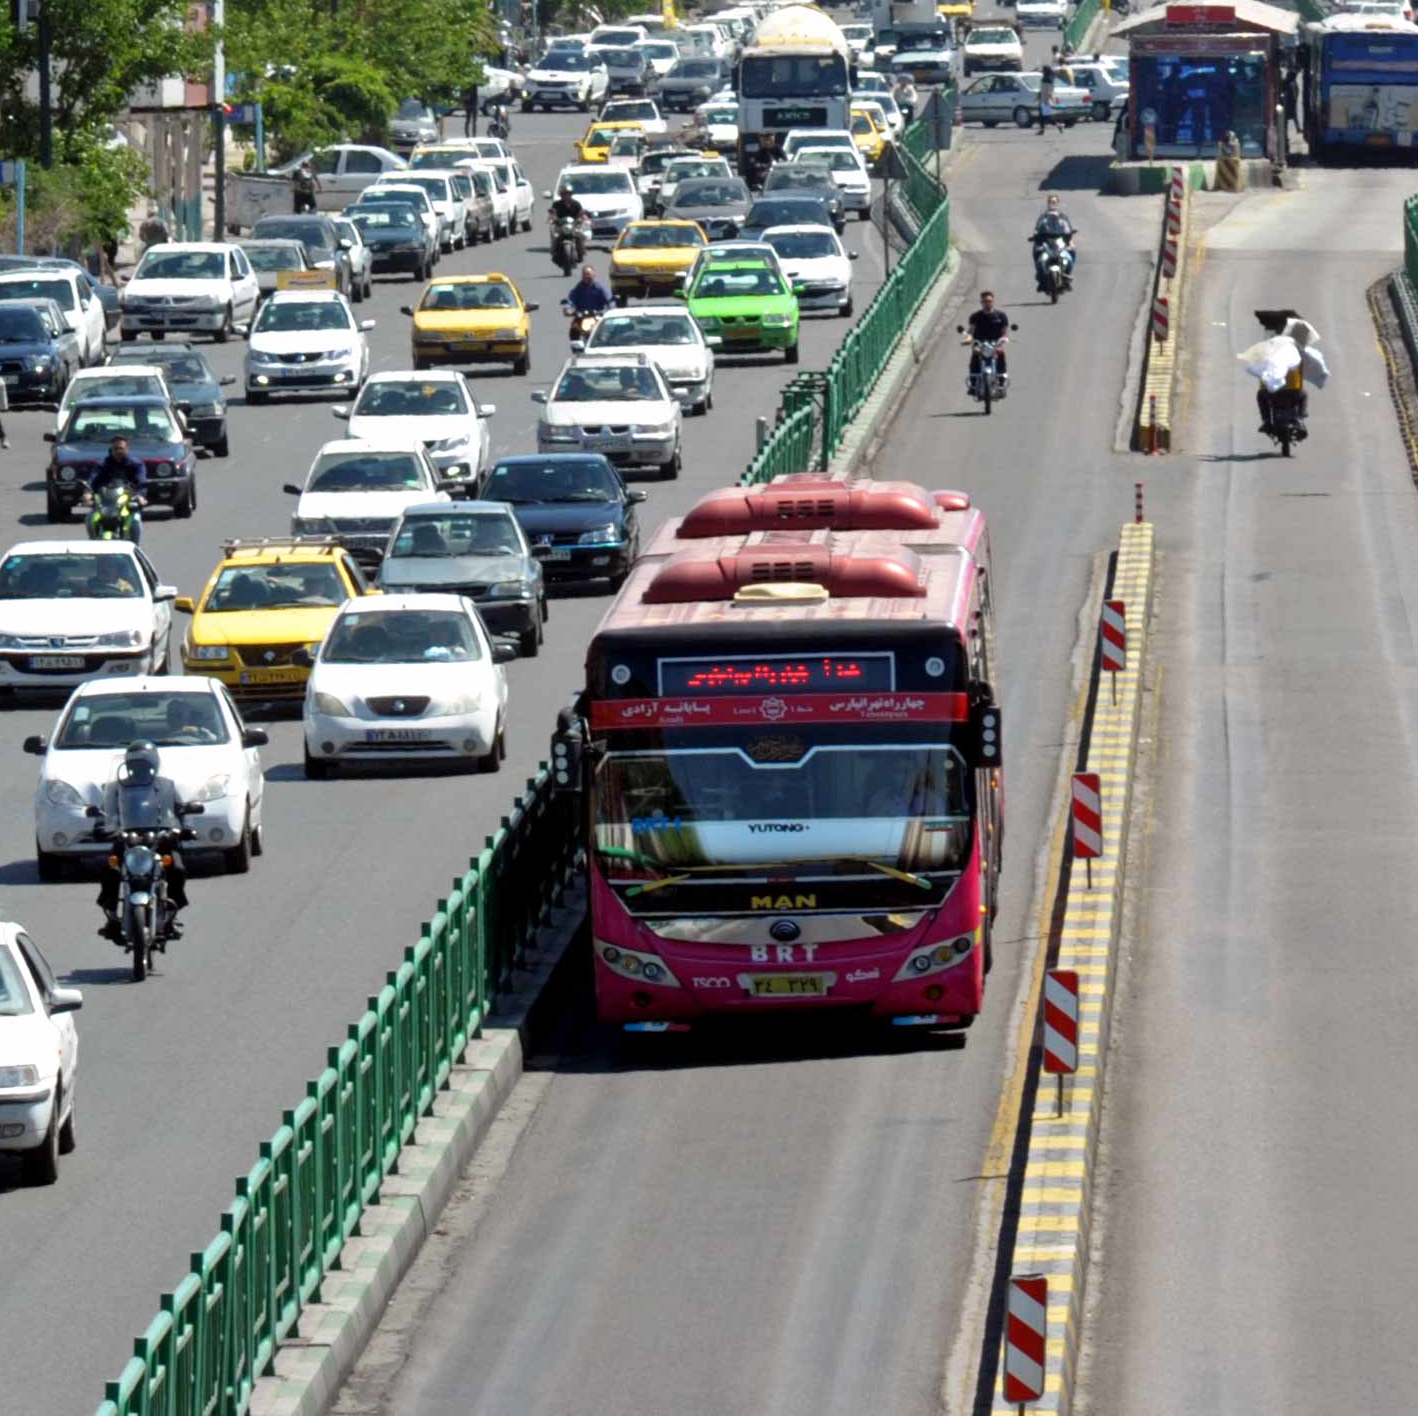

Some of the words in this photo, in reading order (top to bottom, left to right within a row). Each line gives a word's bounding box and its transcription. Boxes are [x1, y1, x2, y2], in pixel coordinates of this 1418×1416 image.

[621, 702, 659, 718] آزادی
[749, 823, 804, 833] YUTONG
[751, 894, 817, 910] MAN
[751, 944, 818, 964] BRT
